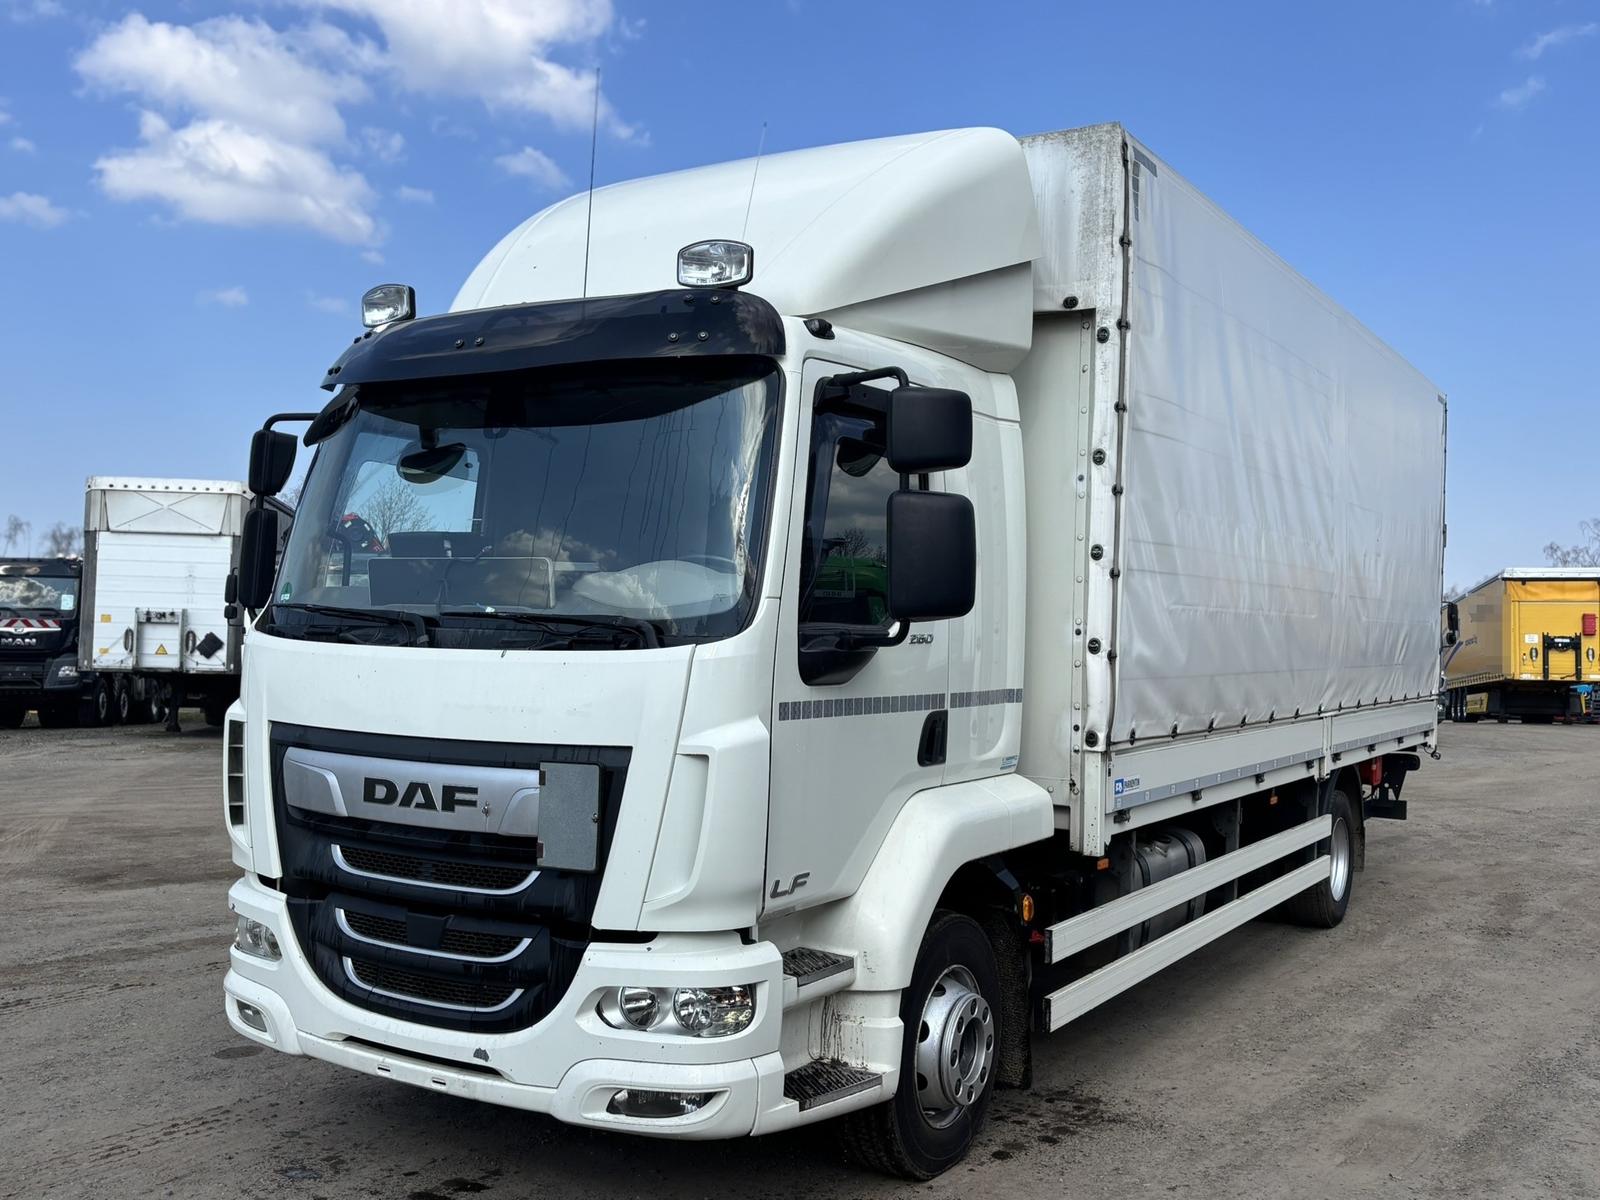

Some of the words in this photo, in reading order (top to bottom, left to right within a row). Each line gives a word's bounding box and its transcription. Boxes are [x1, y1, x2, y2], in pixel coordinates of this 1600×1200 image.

[0, 638, 37, 647] MAN
[364, 777, 478, 813] DAF
[770, 872, 810, 899] LF
